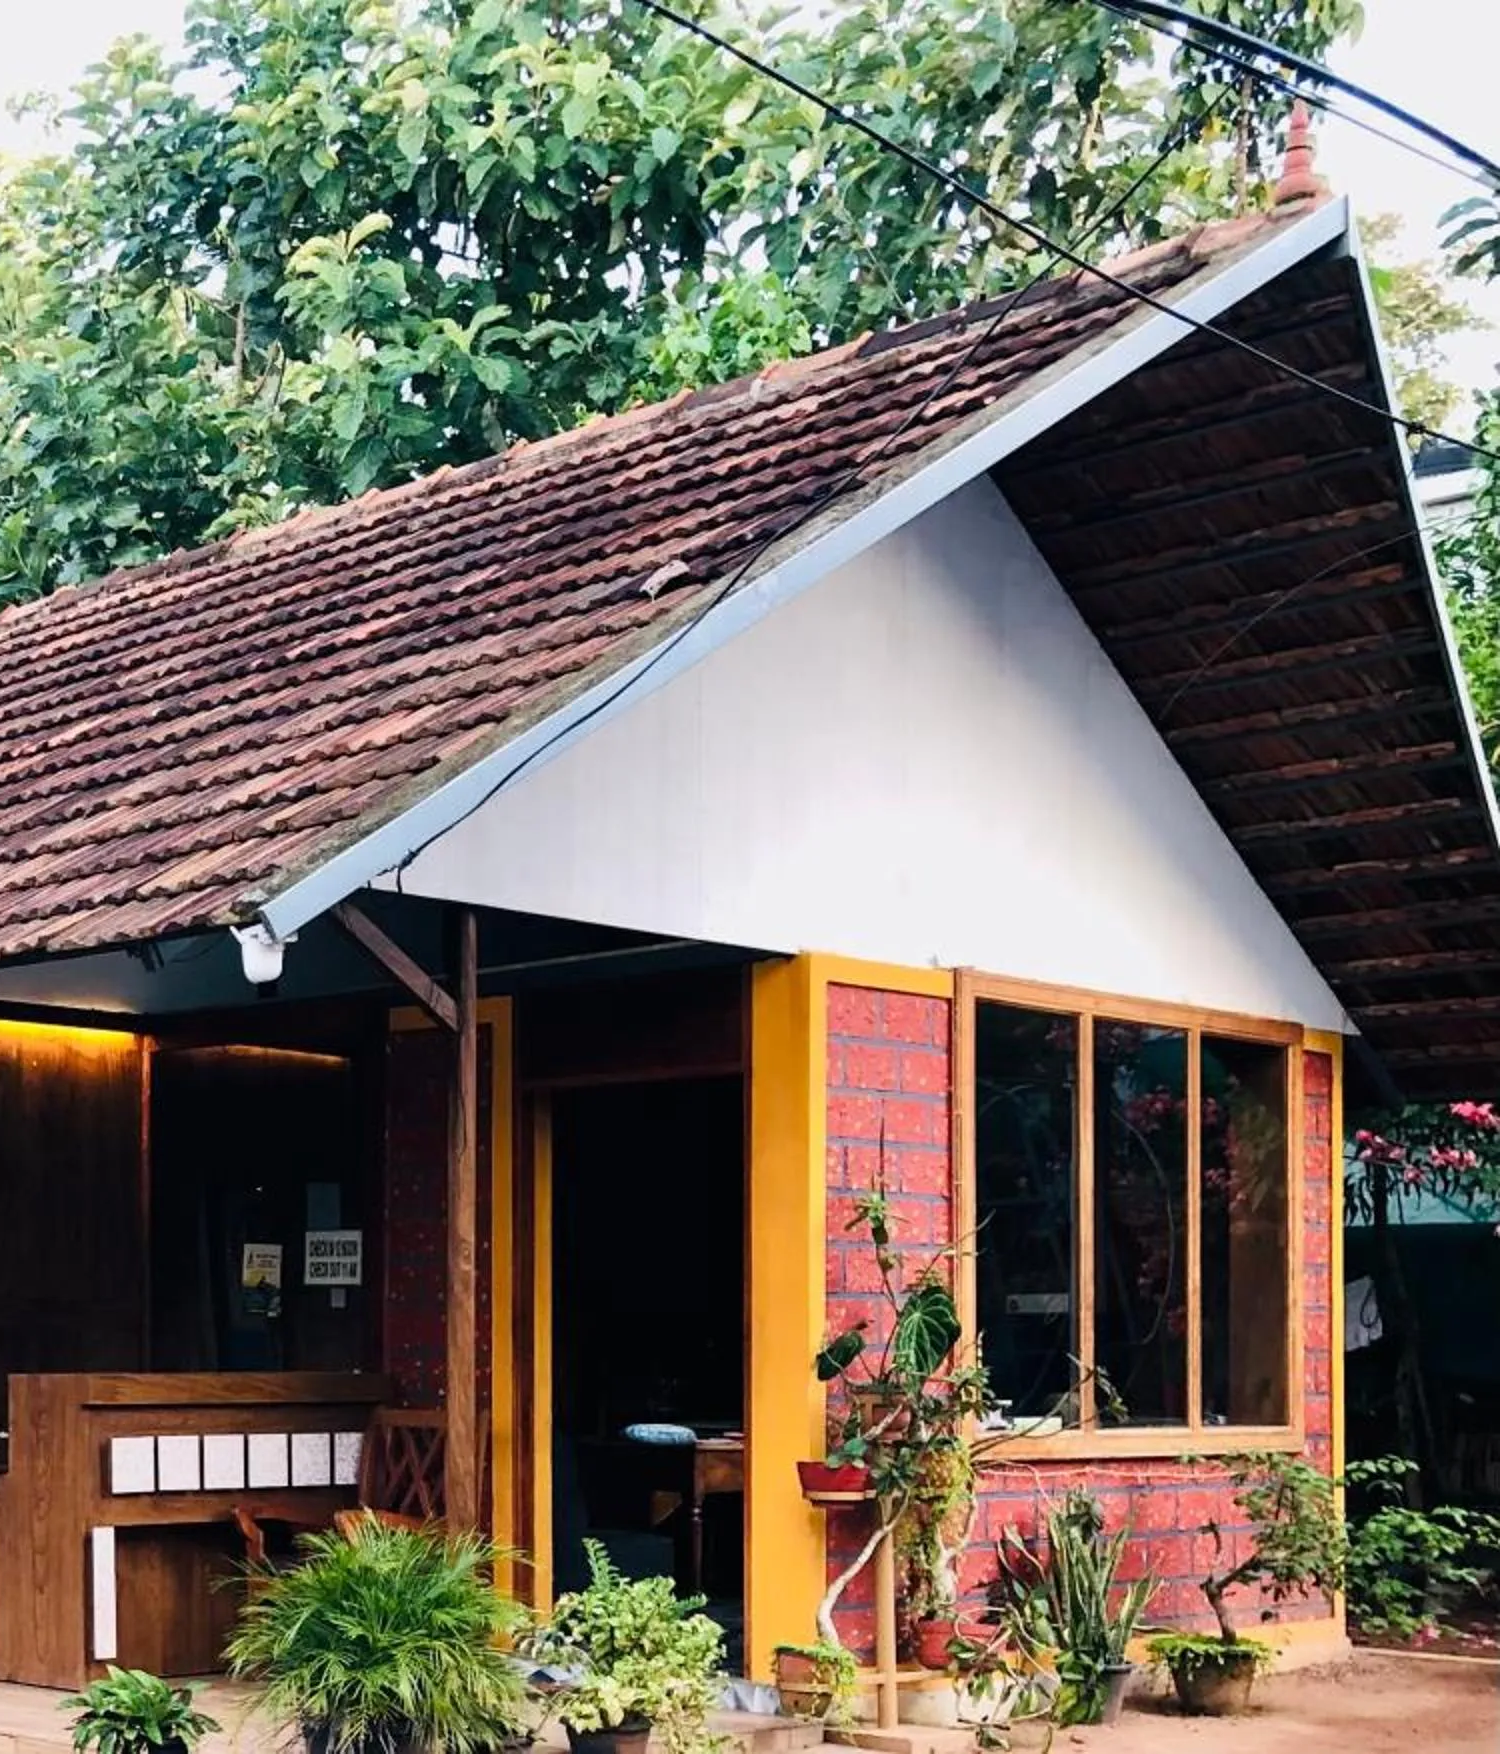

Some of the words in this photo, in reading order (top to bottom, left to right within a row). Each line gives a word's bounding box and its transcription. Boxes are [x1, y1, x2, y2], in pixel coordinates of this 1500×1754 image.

[309, 1240, 328, 1257] CHECK
[309, 1261, 328, 1278] CHECK
[330, 1261, 340, 1278] OUT
